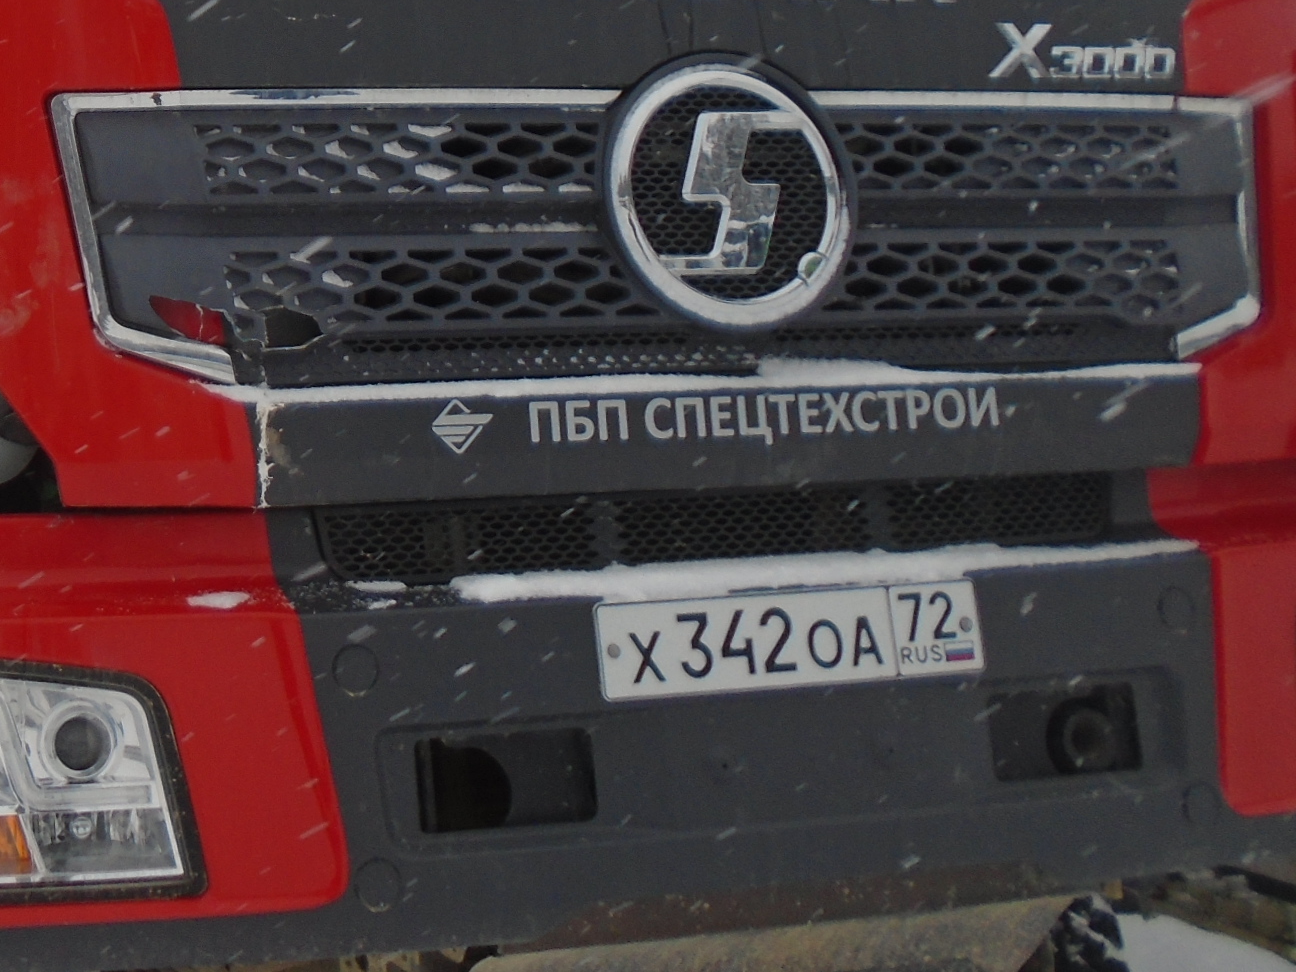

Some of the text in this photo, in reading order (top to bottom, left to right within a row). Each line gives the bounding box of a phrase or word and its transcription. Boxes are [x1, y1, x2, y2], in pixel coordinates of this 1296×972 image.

[988, 22, 1177, 81] X3000
[528, 398, 630, 443] ПБП
[897, 590, 958, 642] 72
[899, 643, 944, 665] RUS
